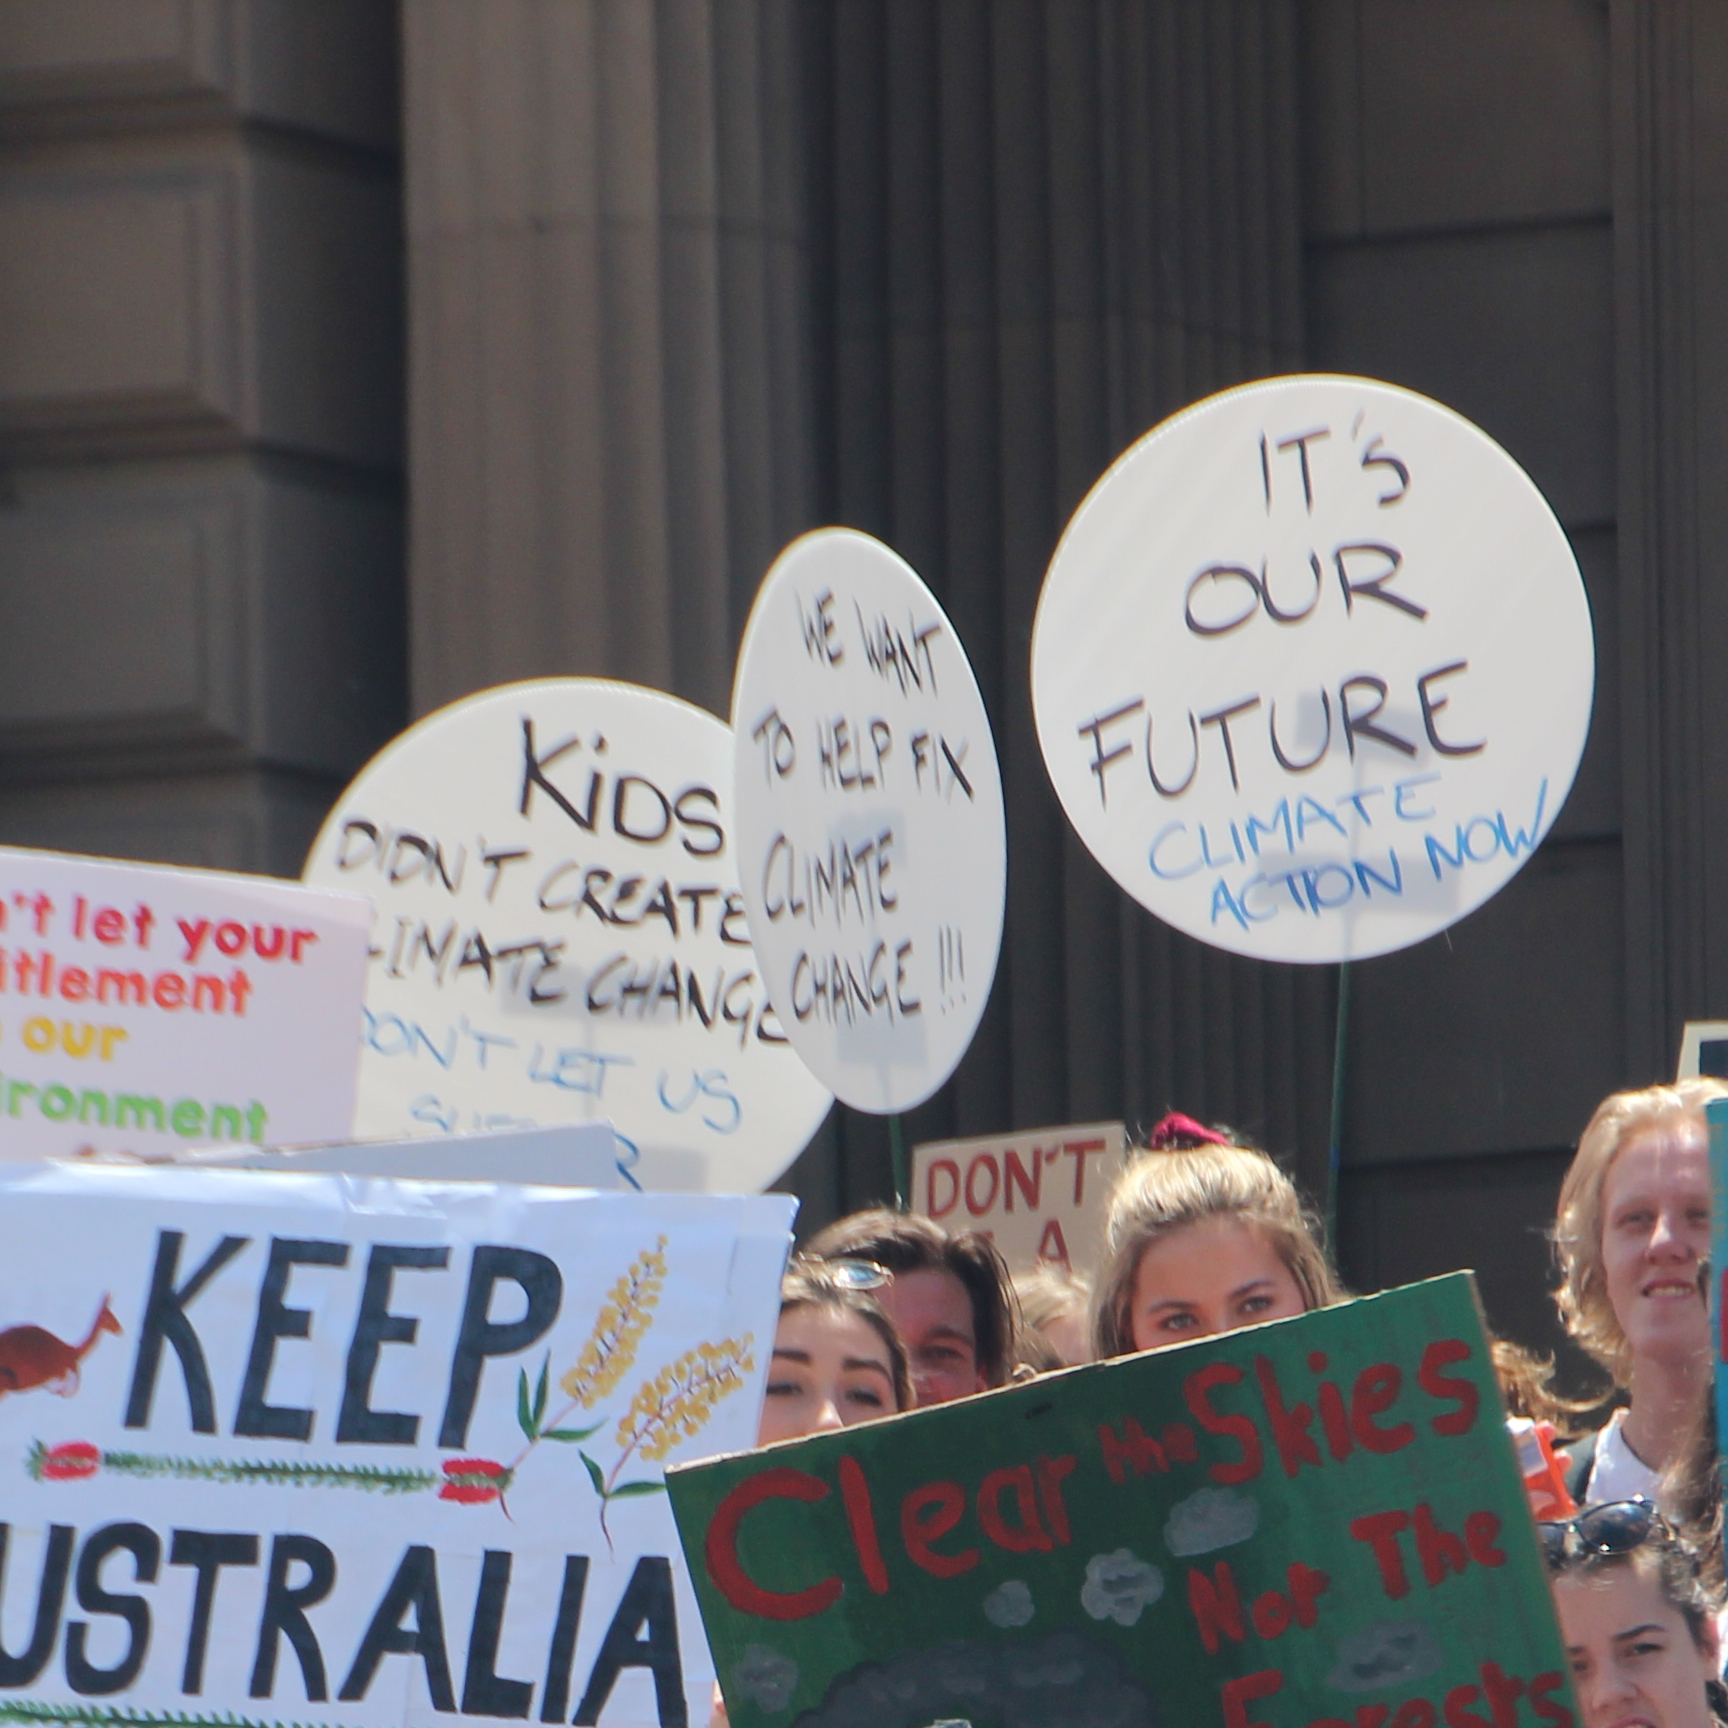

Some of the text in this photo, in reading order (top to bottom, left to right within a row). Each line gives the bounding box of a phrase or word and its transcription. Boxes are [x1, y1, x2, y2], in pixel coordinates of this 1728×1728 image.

[1259, 406, 1412, 517] IT'S
[793, 585, 943, 699] WE WANT
[1182, 538, 1430, 640] OUR
[752, 702, 976, 805] TO HELP FIX
[1077, 654, 1488, 813] FUTURE
[761, 823, 900, 932] CLIMATE
[1147, 769, 1444, 884] CLIMATE
[1209, 774, 1551, 935] ACTION NOW
[72, 895, 157, 950] let
[176, 915, 320, 966] your
[335, 818, 756, 948] DIDN'T CREATE
[789, 935, 922, 1030] CHANGE
[19, 1014, 131, 1063] our
[529, 1038, 636, 1097] LET
[656, 1066, 744, 1136] US
[927, 1138, 1108, 1220] DON'T
[122, 1226, 565, 1451] KEEP
[703, 1453, 1082, 1623] Clear
[1182, 1337, 1482, 1485] Skies
[1350, 1500, 1510, 1602] The
